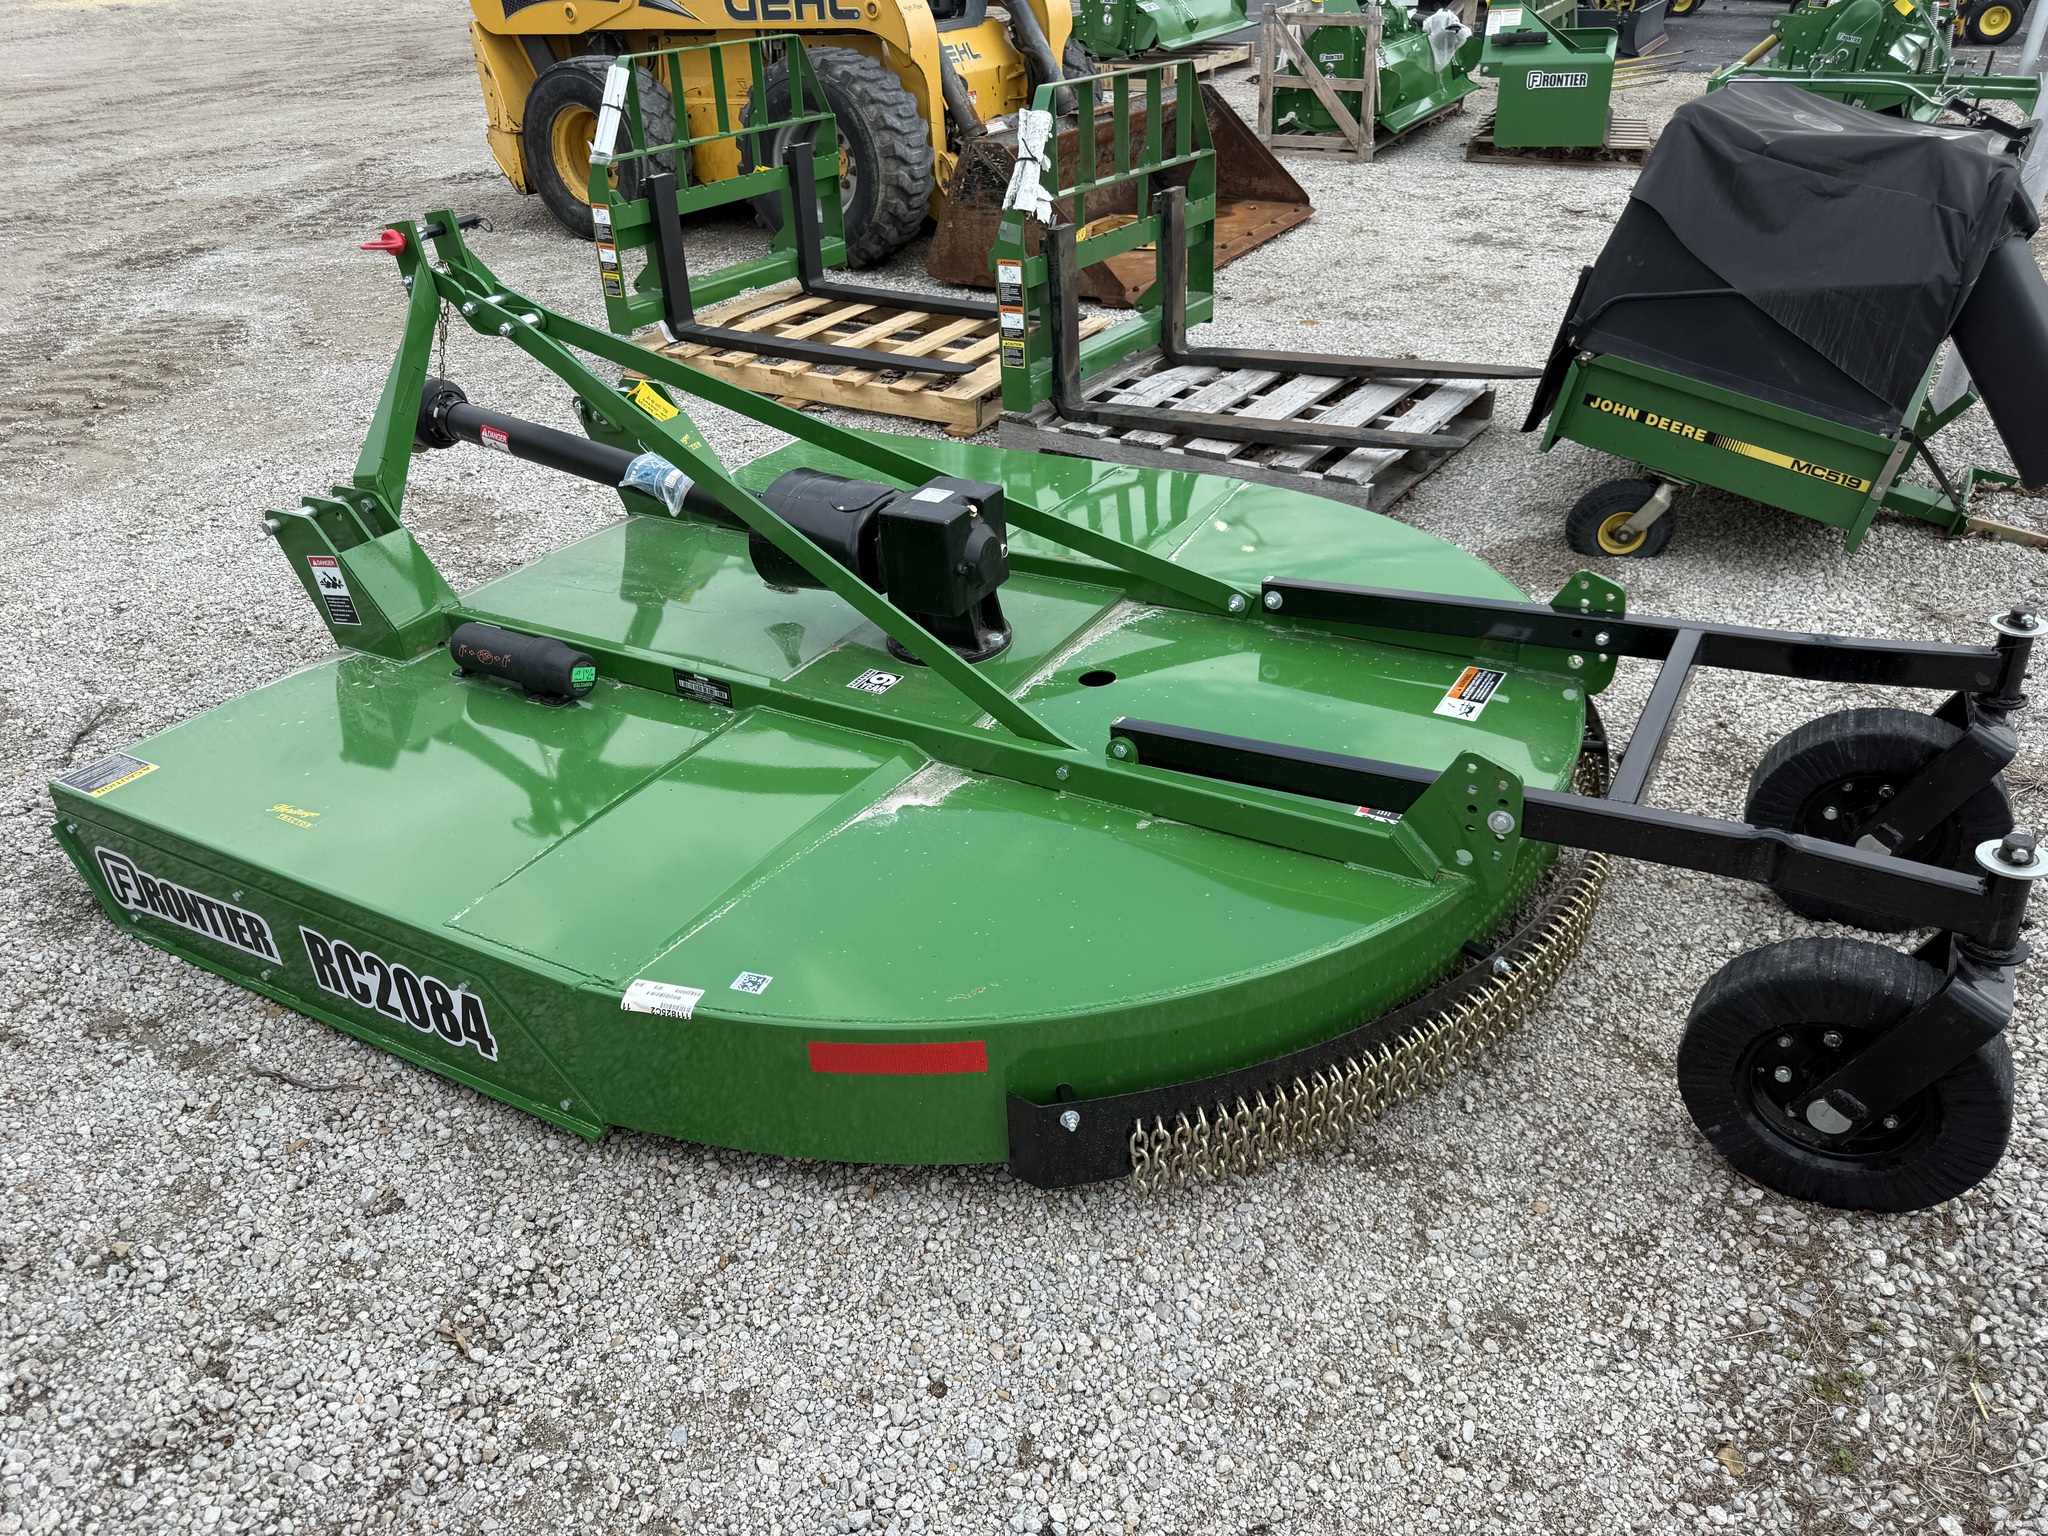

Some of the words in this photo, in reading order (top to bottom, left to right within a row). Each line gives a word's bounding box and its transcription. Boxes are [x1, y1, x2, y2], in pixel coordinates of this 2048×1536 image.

[942, 42, 981, 63] EHL
[1527, 71, 1588, 89] FRONTIER
[1590, 397, 1639, 421] JOHN
[1645, 412, 1708, 442] DEERE
[487, 429, 507, 443] DANGER
[1790, 458, 1863, 490] MC519
[97, 770, 143, 793] CAUTION
[98, 849, 278, 960] FRONTIER
[303, 930, 495, 1057] RC2084
